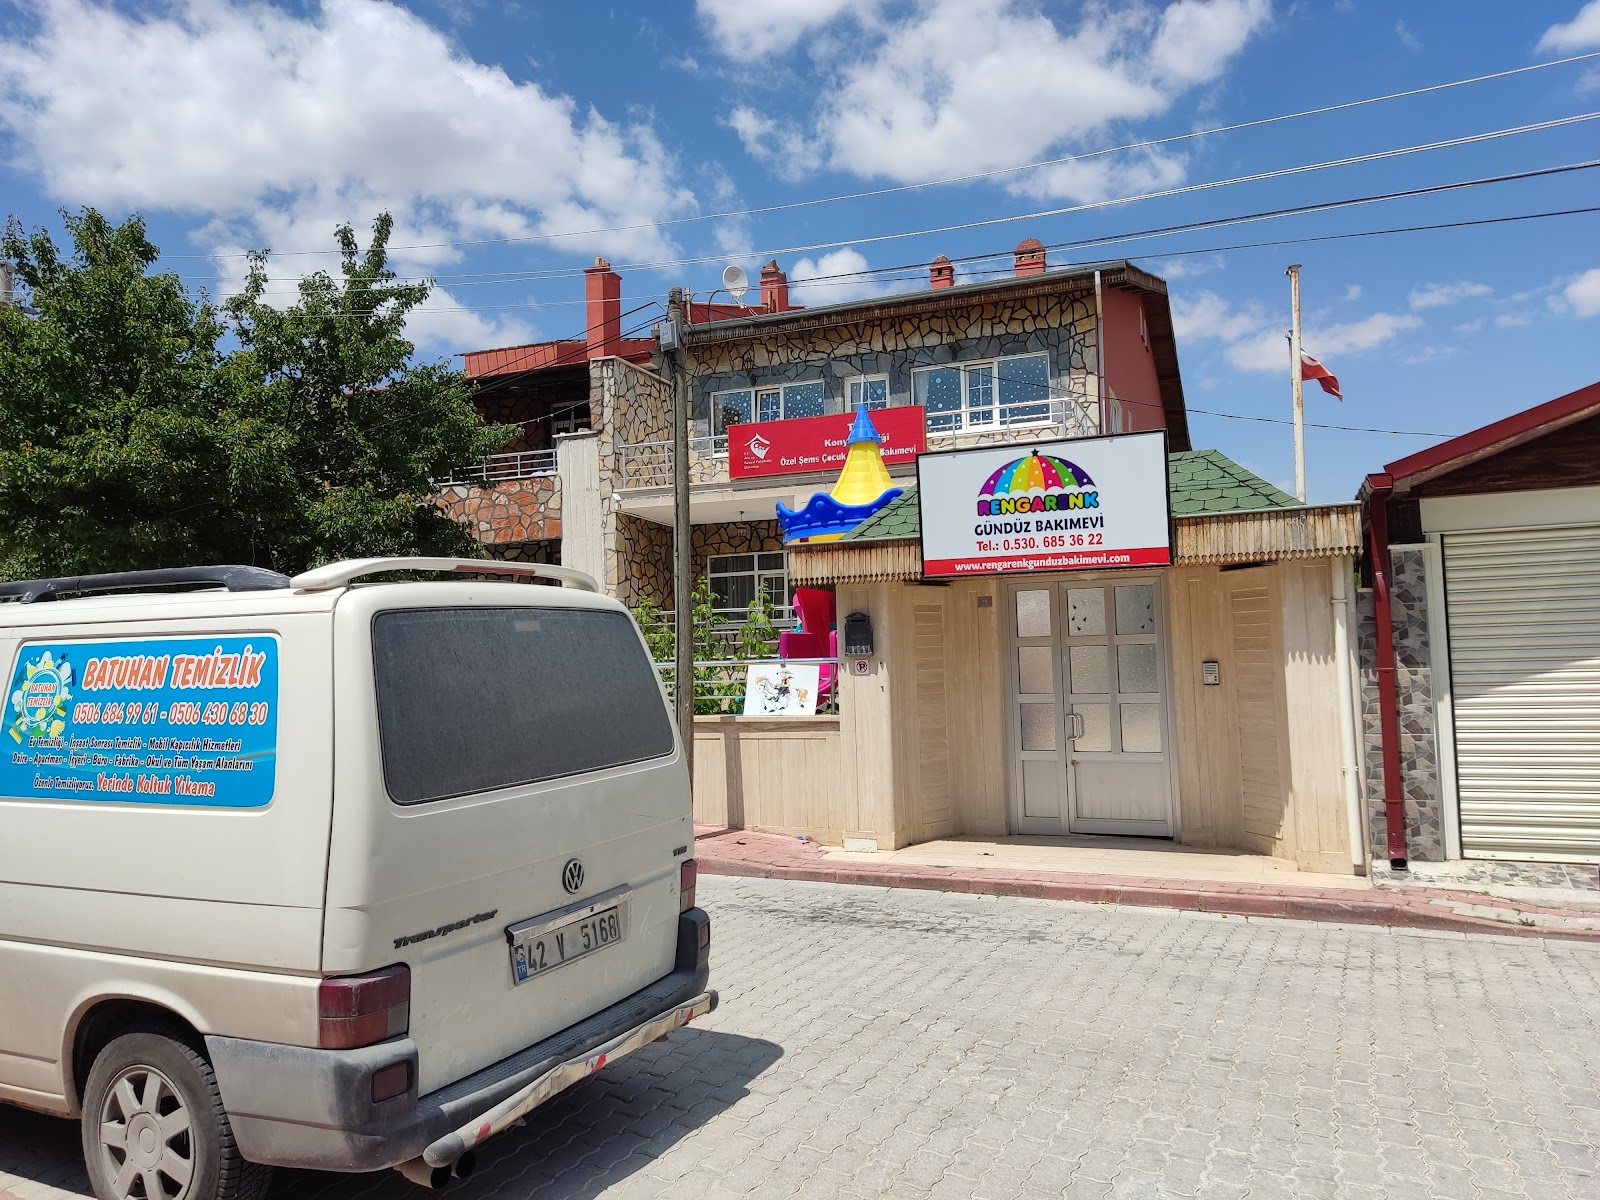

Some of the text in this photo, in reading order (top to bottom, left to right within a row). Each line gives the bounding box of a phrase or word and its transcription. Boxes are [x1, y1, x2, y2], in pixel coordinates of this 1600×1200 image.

[824, 439, 847, 447] Kony
[780, 456, 796, 466] Özel
[799, 456, 819, 465] Şems
[822, 452, 846, 463] Çocuk
[880, 445, 916, 457] Bakımevi
[977, 491, 1099, 516] RENGARENK
[974, 512, 1104, 536] GÜNDÜZ BAKIMEVİ
[976, 533, 1103, 552] Tel.: 0.530. 685 36 22
[954, 553, 1130, 571] www.rengarenkgunduzbakimevi.com
[83, 645, 265, 690] BATUHAN TEMİZLİK
[30, 683, 56, 693] BATUHAN
[73, 702, 101, 724] 0506
[102, 702, 125, 724] 684
[125, 702, 142, 724] 99
[142, 702, 159, 724] 61
[169, 702, 201, 725] 0506
[201, 702, 228, 725] 430
[229, 702, 248, 725] 68
[248, 702, 268, 725] 30
[29, 737, 36, 747] Ev
[37, 737, 64, 750] Temizliği
[69, 734, 88, 750] İnşaat
[90, 738, 113, 748] Sonrası
[115, 737, 141, 749] Temizlik
[148, 737, 168, 750] Mobil
[170, 738, 200, 753] Kapıcılık
[202, 738, 241, 751] Hizmetleri
[12, 752, 28, 764] Daire
[33, 752, 62, 766] Apartman
[92, 753, 108, 765] Büro
[114, 754, 139, 766] Fabrika
[146, 755, 163, 768] Okul
[164, 759, 172, 768] ve
[174, 756, 188, 768] Tüm
[190, 757, 213, 771] Yaşam
[215, 757, 252, 770] Alanlarını
[34, 773, 53, 788] Özenle
[97, 772, 133, 791] Yerinde
[136, 775, 171, 793] Koltuk
[174, 776, 215, 795] Yıkama
[393, 909, 498, 949] Transporter
[528, 914, 617, 971] 42 V 5168
[517, 964, 526, 974] TR
